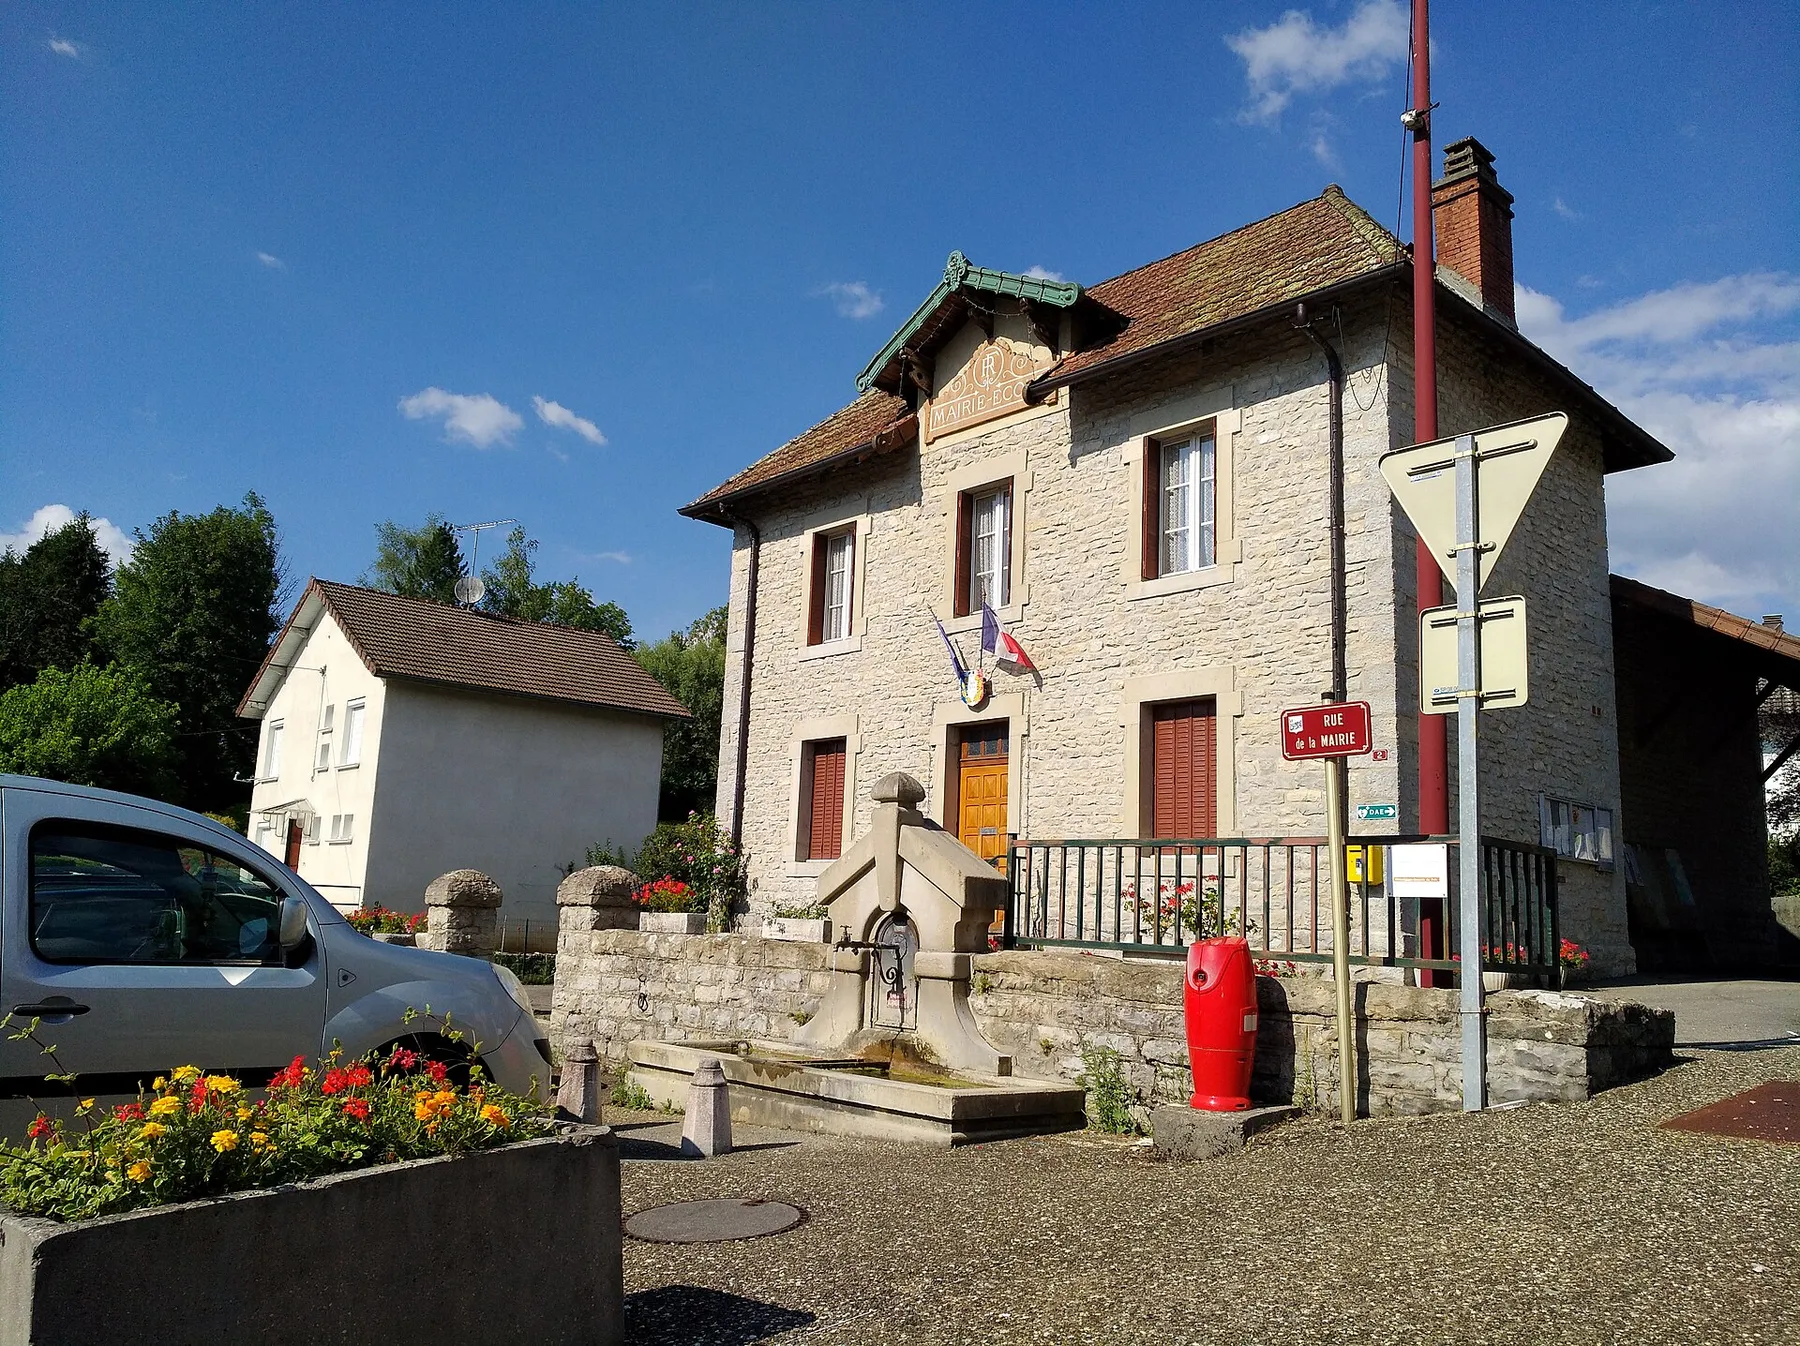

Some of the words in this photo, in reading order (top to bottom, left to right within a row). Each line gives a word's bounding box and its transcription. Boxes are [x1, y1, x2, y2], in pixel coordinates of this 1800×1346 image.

[933, 381, 1025, 427] MAIRIE-ECO
[1323, 713, 1344, 728] RUE
[1295, 738, 1305, 750] de
[1308, 736, 1316, 749] la
[1320, 732, 1356, 748] MAIRIE
[1376, 751, 1383, 759] 2
[1369, 808, 1385, 816] DAE
